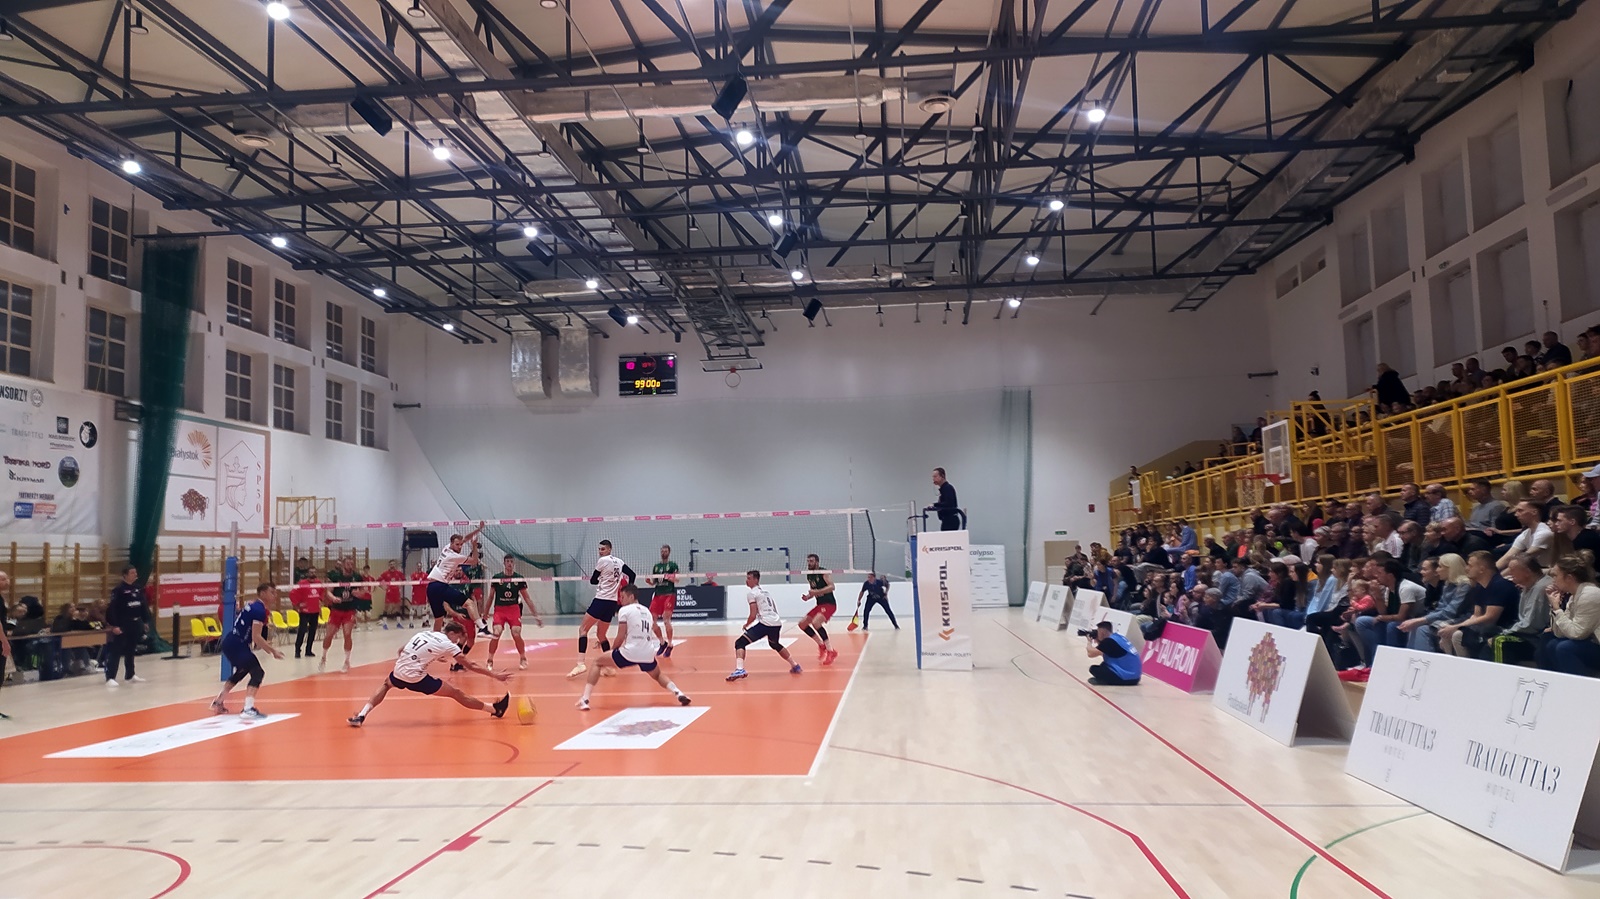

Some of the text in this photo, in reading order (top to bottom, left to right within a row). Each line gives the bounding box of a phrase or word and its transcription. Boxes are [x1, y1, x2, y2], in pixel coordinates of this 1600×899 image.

[939, 560, 950, 627] KRISPOL
[412, 636, 429, 651] 47
[641, 620, 650, 632] 14
[1156, 638, 1200, 676] TAURON
[1521, 689, 1535, 717] T
[1369, 710, 1437, 752] TRAUGUTTA3
[1465, 739, 1561, 795] TRAUGUTTA3
